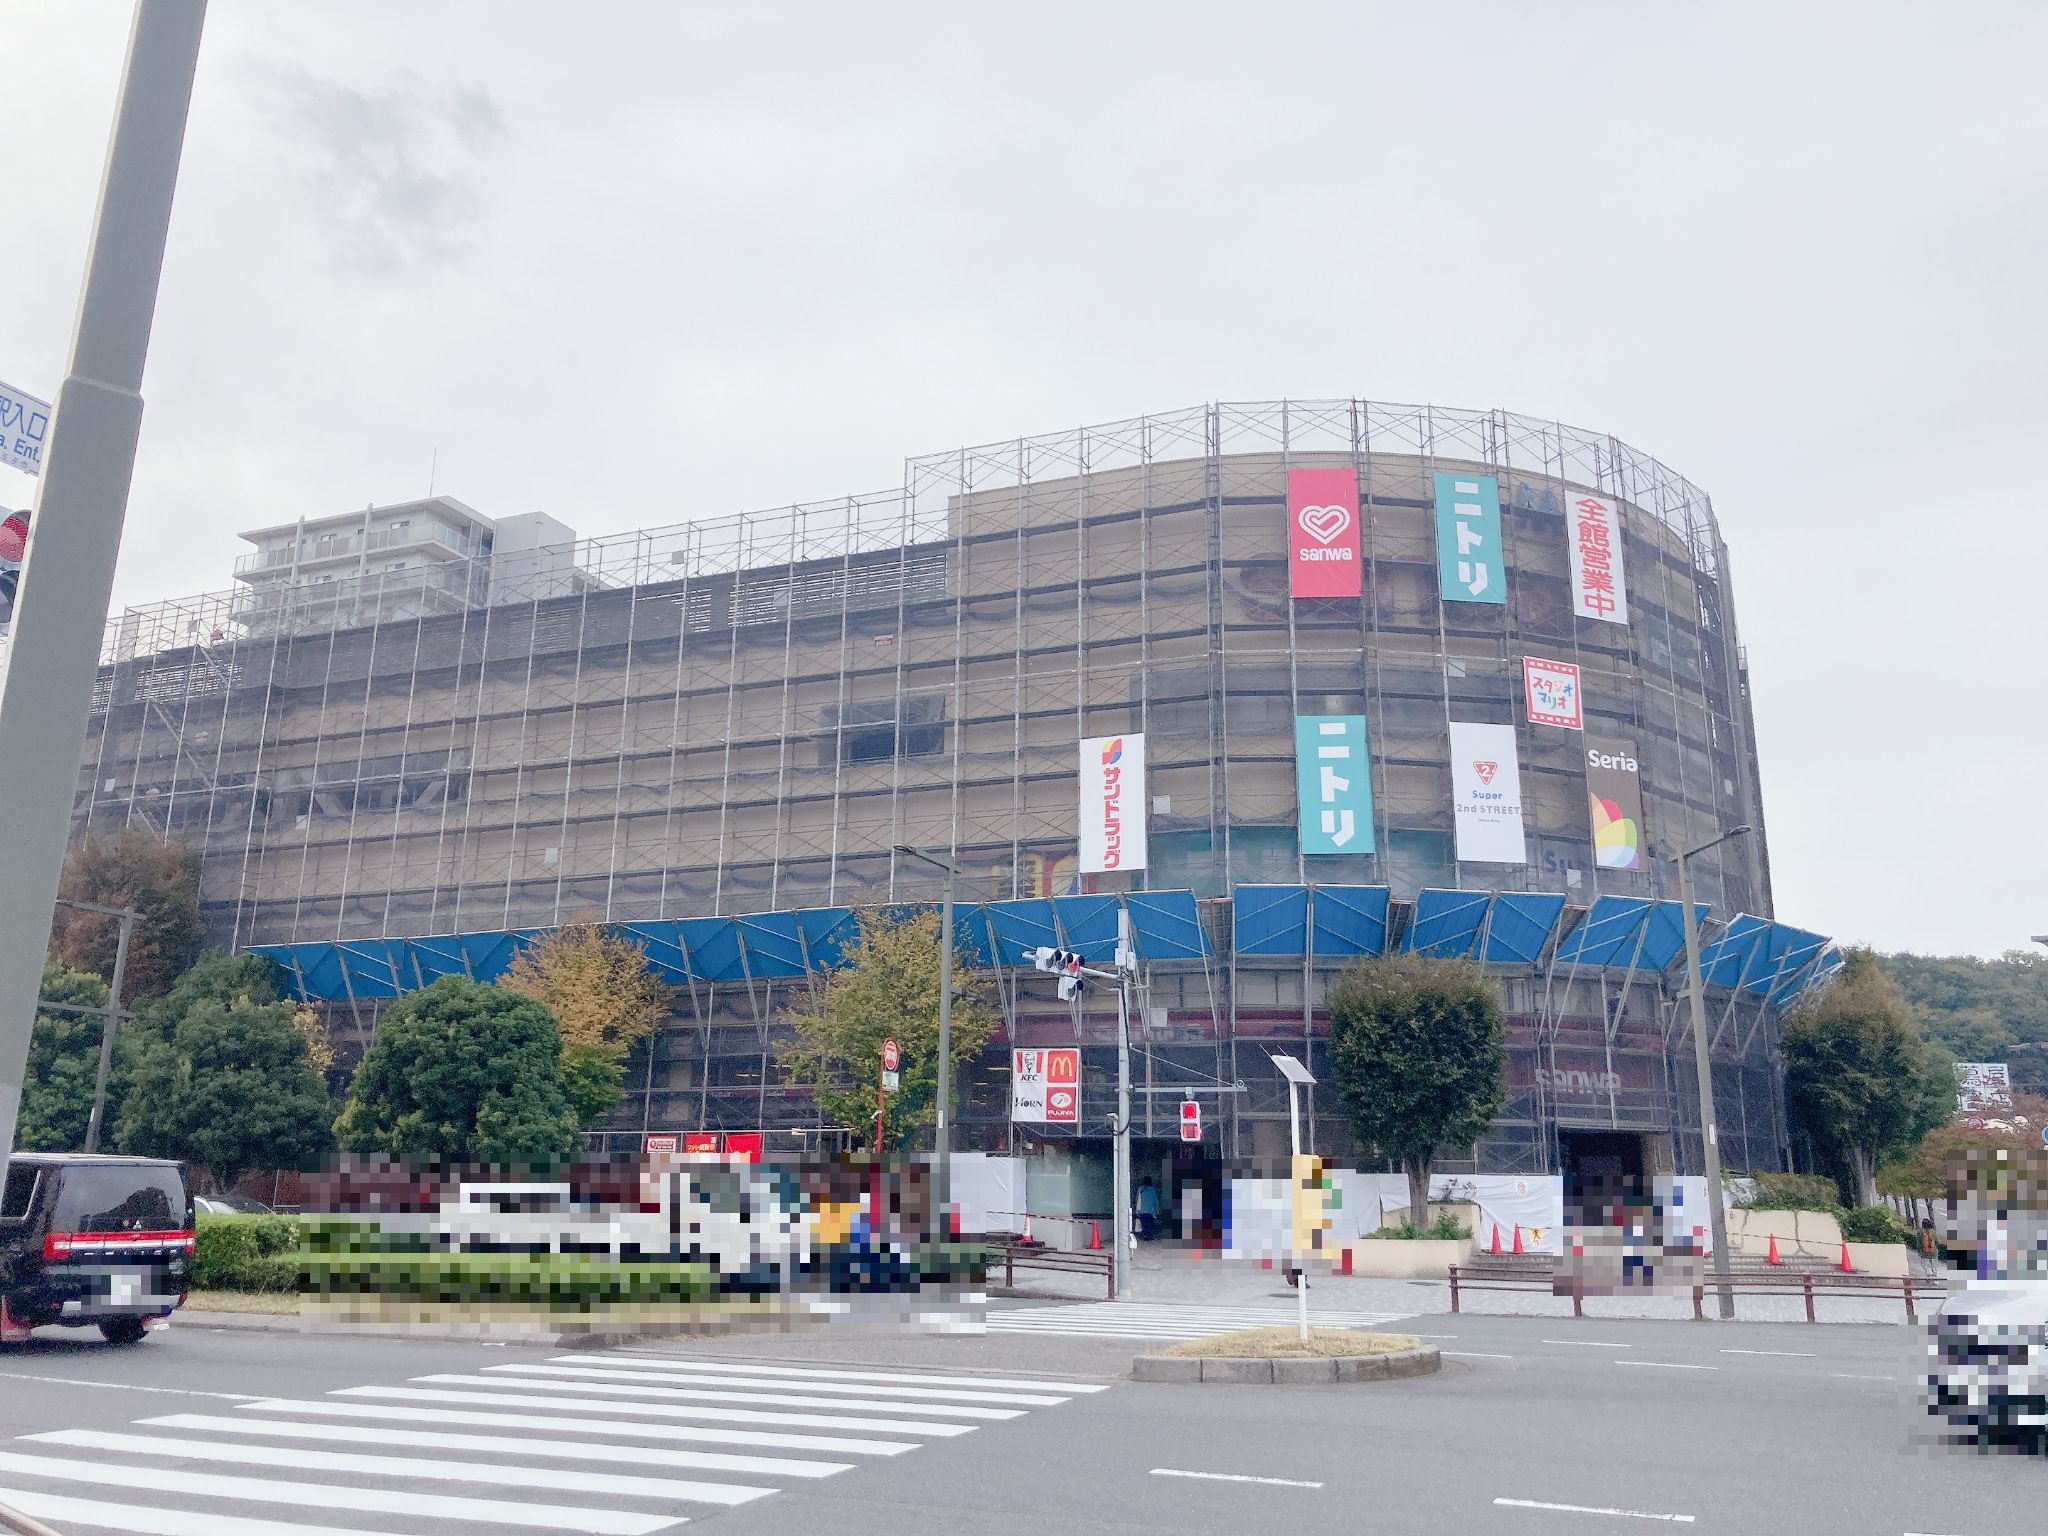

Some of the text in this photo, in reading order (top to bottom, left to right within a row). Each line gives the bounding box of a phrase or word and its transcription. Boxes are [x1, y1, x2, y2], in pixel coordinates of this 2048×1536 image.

[13, 437, 40, 463] Ent.
[1454, 481, 1488, 597] ニトリ
[1299, 547, 1352, 562] sanwa
[1575, 497, 1616, 617] 全館営業中
[1532, 676, 1573, 697] スタジオ
[1537, 691, 1567, 710] マリオ
[1588, 749, 1638, 772] Seria
[1318, 722, 1355, 848] ニトリ
[1472, 790, 1503, 800] Super
[1103, 766, 1121, 869] サンドラッグ
[1456, 804, 1521, 815] 2nd STREET
[1021, 1074, 1039, 1082] KFC
